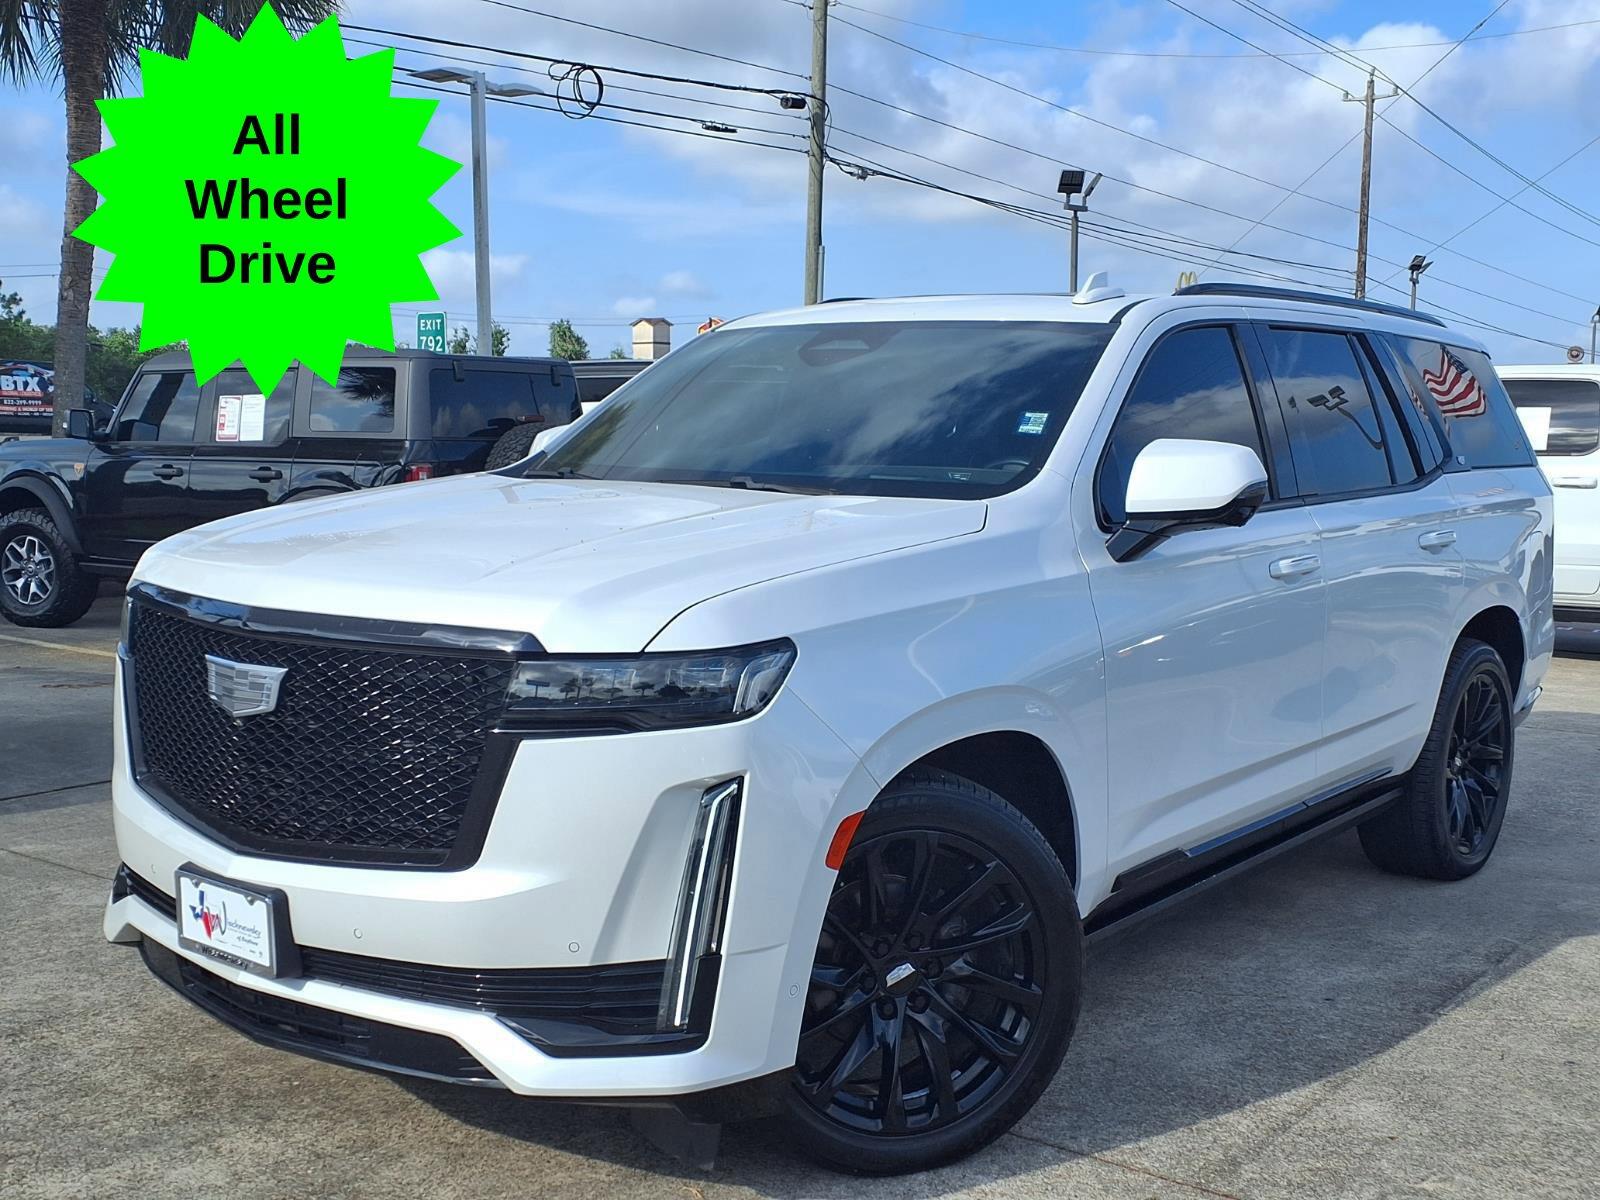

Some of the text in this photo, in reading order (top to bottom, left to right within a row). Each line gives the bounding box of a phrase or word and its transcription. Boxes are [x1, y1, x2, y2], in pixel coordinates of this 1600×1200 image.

[420, 319, 442, 331] EXIT
[419, 335, 443, 352] 792
[0, 375, 41, 392] BTX
